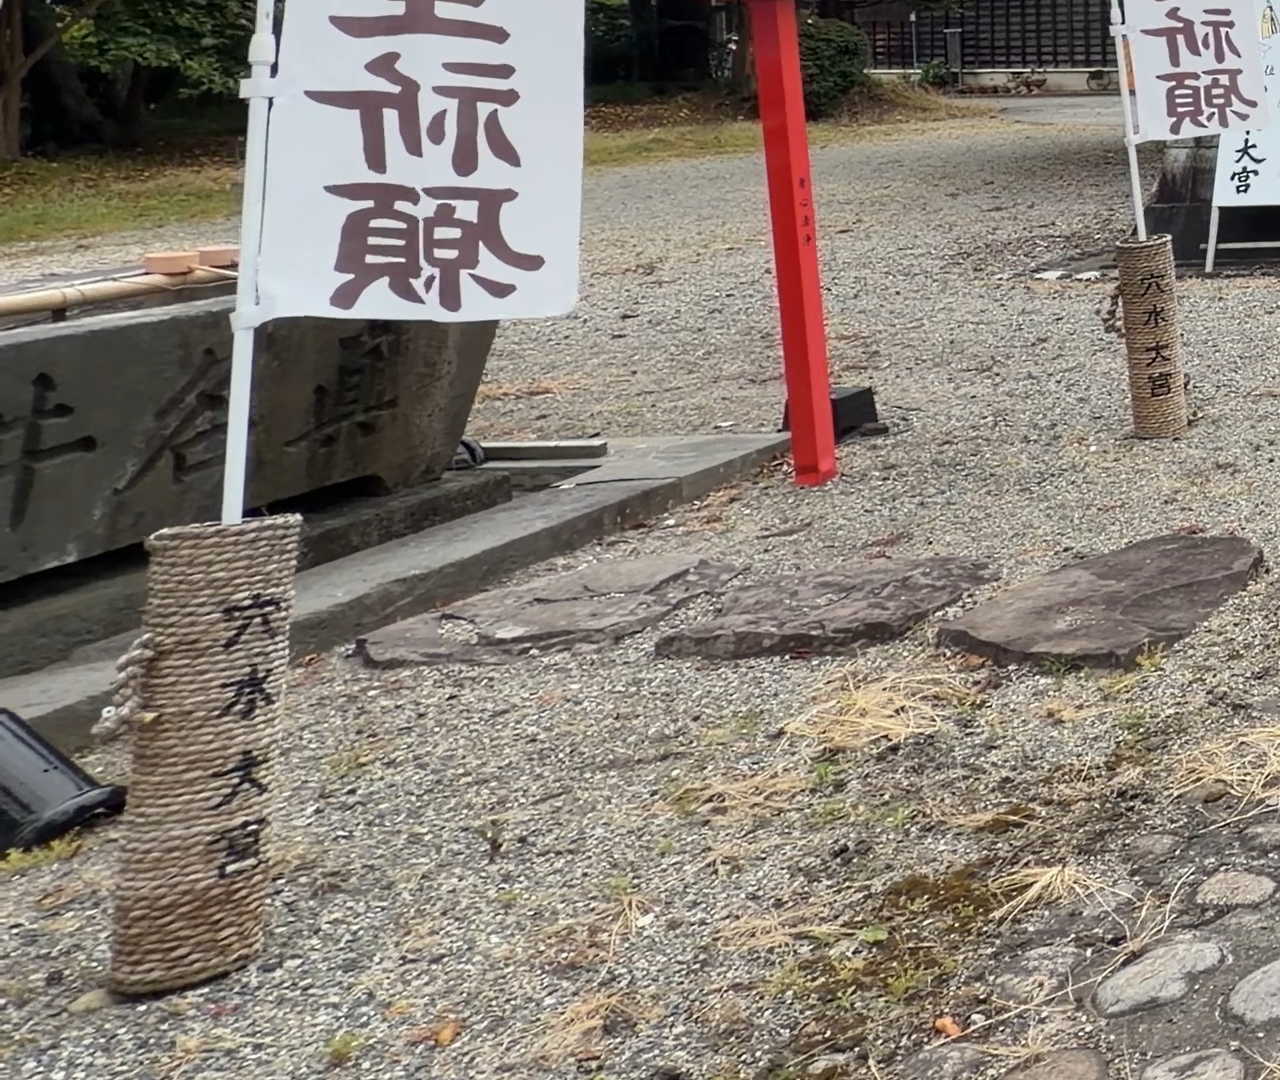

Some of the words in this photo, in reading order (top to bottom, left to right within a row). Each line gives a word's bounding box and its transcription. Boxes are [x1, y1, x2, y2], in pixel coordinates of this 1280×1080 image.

[1230, 133, 1267, 195] 大宮
[1140, 273, 1173, 398] 穴水大宮
[211, 591, 283, 881] 穴水大宮
